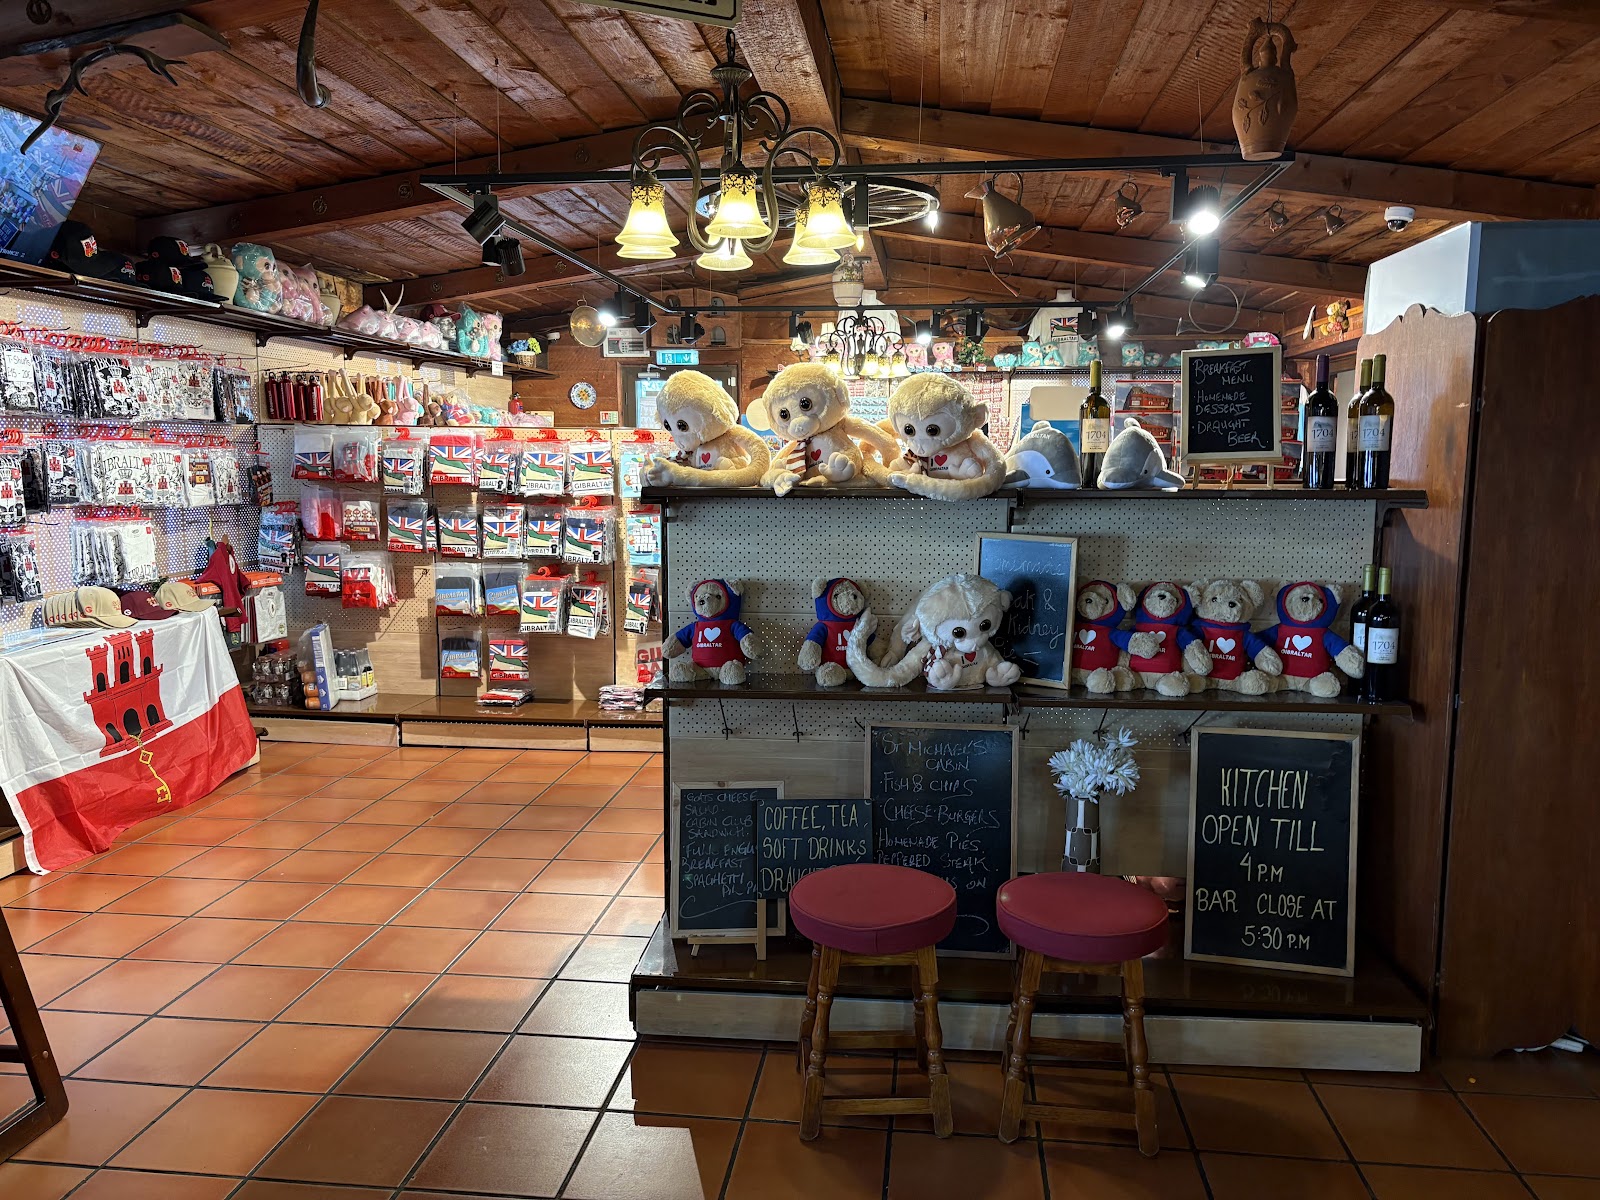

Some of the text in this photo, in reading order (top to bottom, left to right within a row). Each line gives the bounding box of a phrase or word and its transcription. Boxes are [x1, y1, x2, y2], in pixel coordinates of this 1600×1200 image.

[1222, 373, 1254, 386] MENU
[1196, 389, 1248, 404] HOMEMADE
[1195, 402, 1253, 417] DESSERTS
[1197, 418, 1251, 435] DRAUGHT
[1312, 428, 1335, 440] 1704
[1362, 427, 1386, 440] 1704
[1085, 430, 1107, 441] 1704
[1350, 431, 1359, 440] 17
[431, 475, 461, 484] GIBRALT
[697, 631, 703, 643] I
[1007, 613, 1065, 650] Kidney
[696, 641, 723, 649] GIBRALTAR
[1208, 639, 1215, 653] I
[1283, 636, 1291, 649] I
[1372, 640, 1396, 651] 1704
[1280, 648, 1313, 659] GIBRALTAR
[925, 755, 970, 773] CABIN
[883, 770, 978, 801] FISH & CHIPS
[1221, 767, 1310, 810] KITCHEN
[716, 790, 758, 803] CHEESE
[685, 816, 718, 828] CABIN
[1201, 814, 1325, 852] OPEN TILL
[685, 841, 720, 858] FULL
[762, 837, 804, 861] SOFT
[681, 857, 747, 874] BREAKFAST
[876, 849, 931, 868] PEPPERED
[1239, 851, 1252, 882] 4
[685, 872, 745, 890] SPAGHETTI
[965, 877, 987, 890] ON
[1195, 887, 1338, 921] BAR CLOSE AT
[1241, 925, 1283, 950] 5:30
